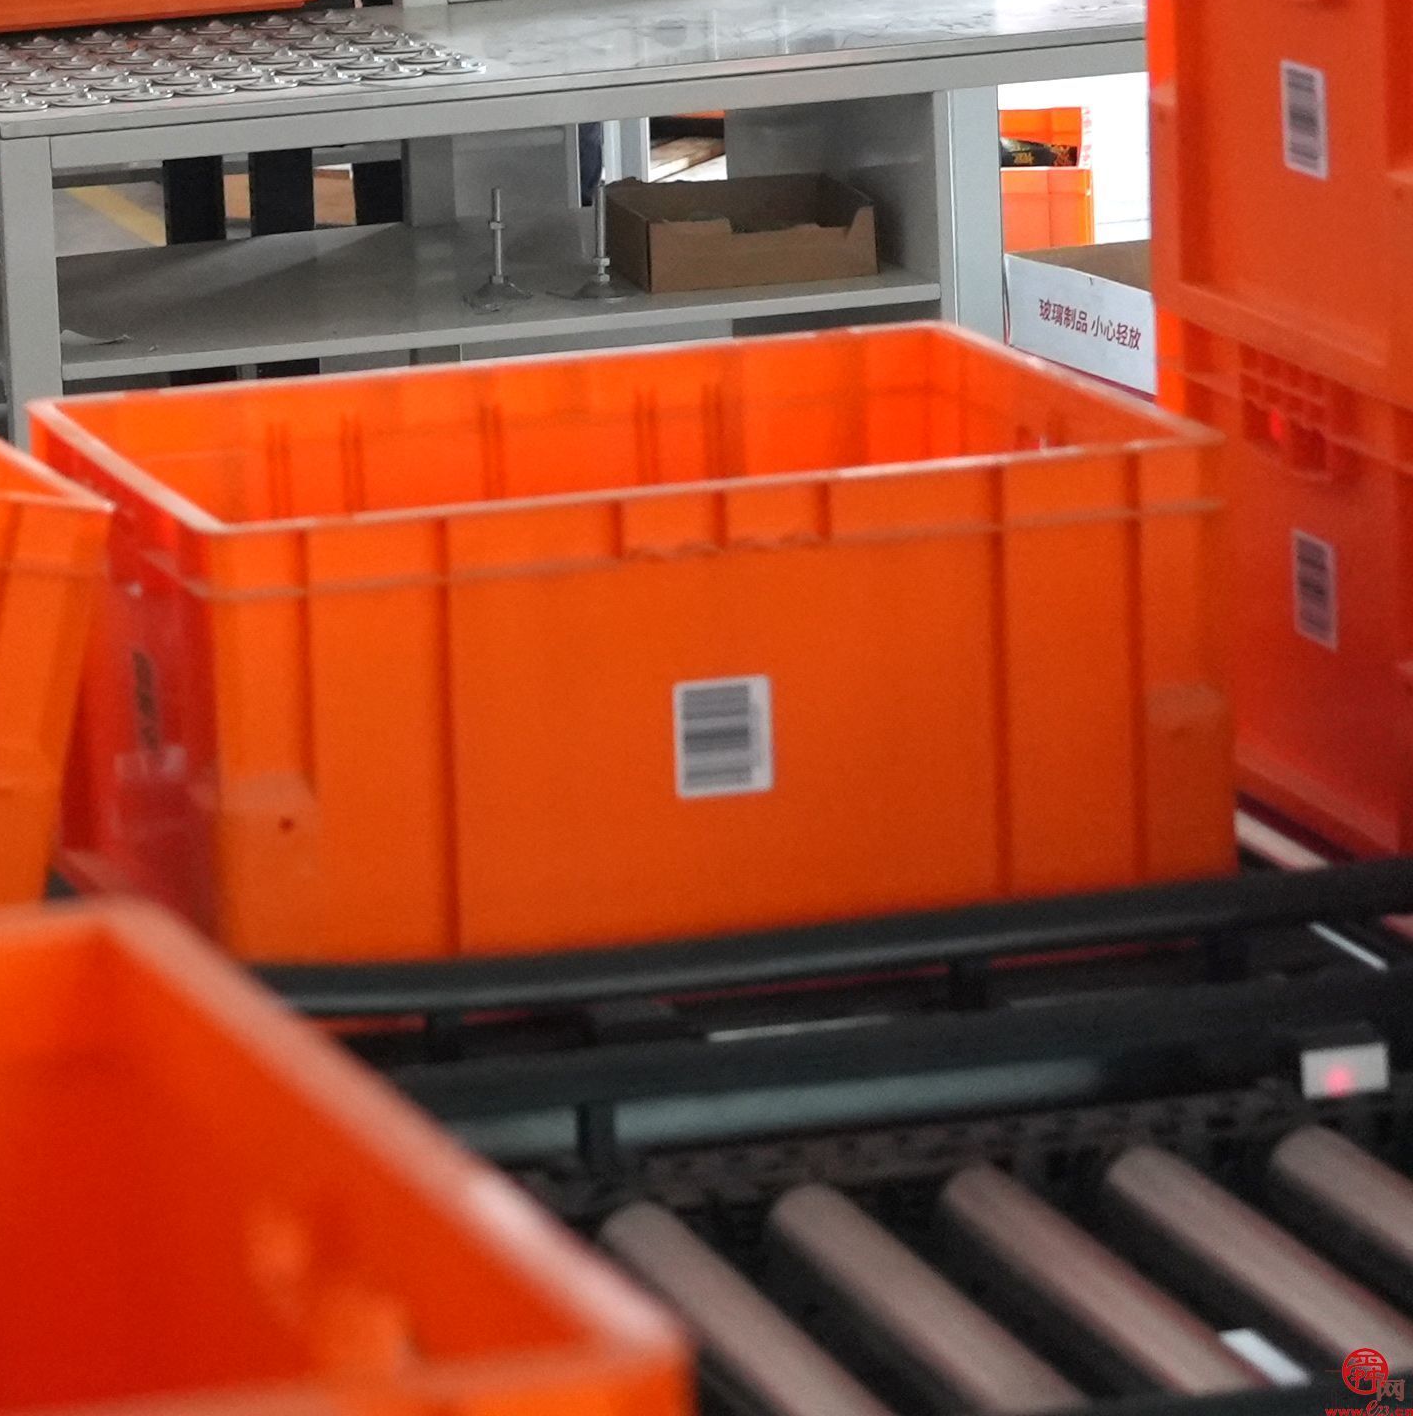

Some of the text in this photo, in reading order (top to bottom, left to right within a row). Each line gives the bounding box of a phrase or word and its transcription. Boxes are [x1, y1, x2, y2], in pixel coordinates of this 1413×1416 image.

[1039, 298, 1142, 351] 玻璃制品 小心轻放
